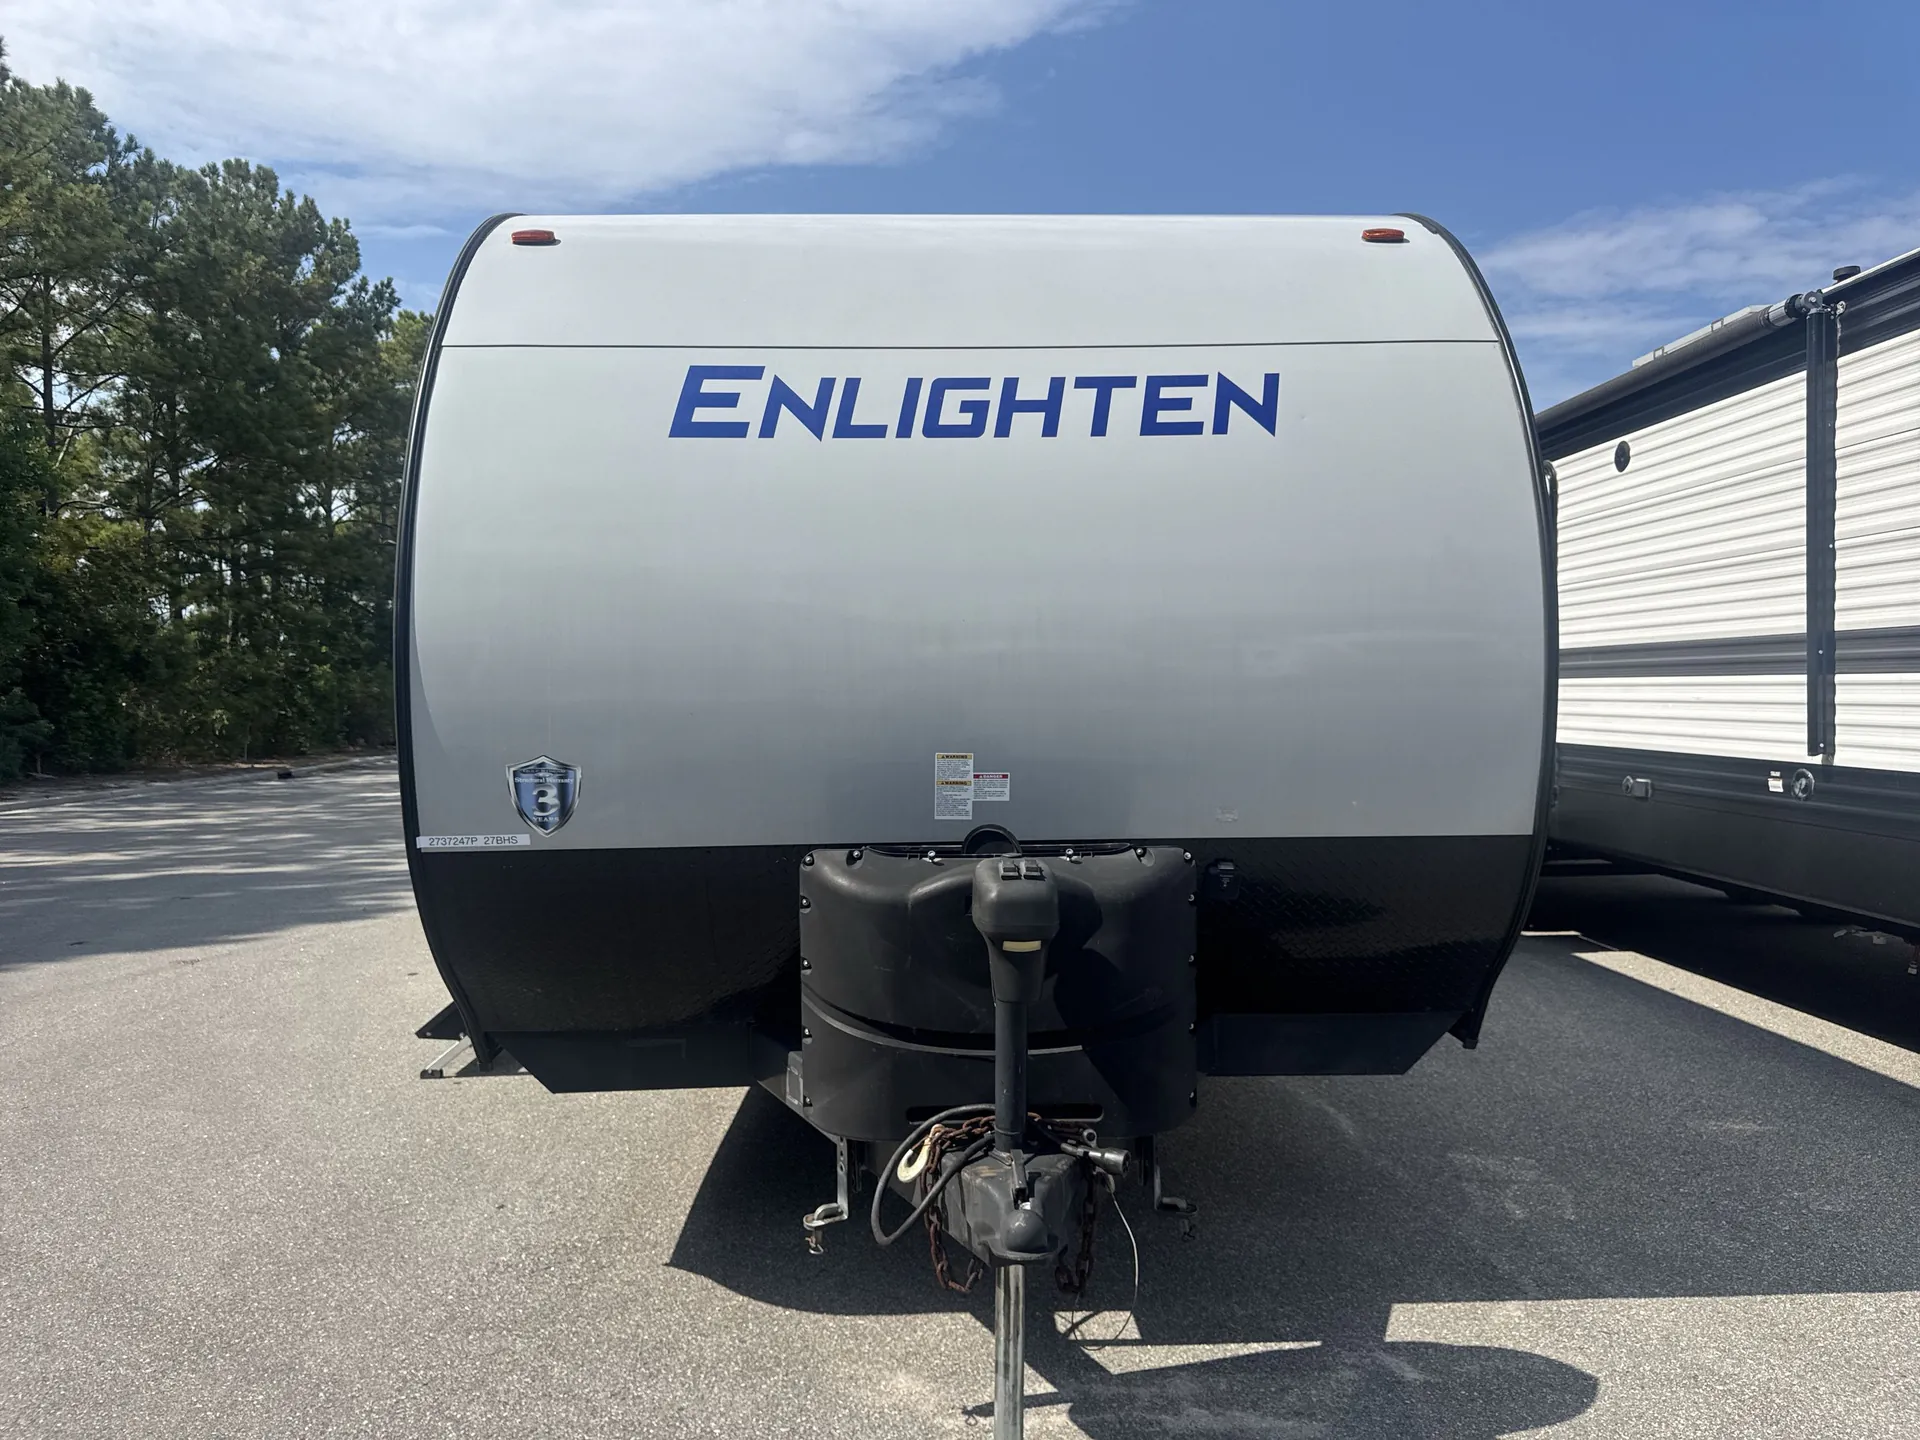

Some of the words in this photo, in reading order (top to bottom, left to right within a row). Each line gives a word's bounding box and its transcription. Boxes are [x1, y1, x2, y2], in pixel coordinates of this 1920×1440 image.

[668, 365, 1280, 441] ENLIGHTEN
[532, 783, 560, 816] 3
[429, 837, 478, 846] 2737247P
[484, 836, 518, 845] 27BHS
